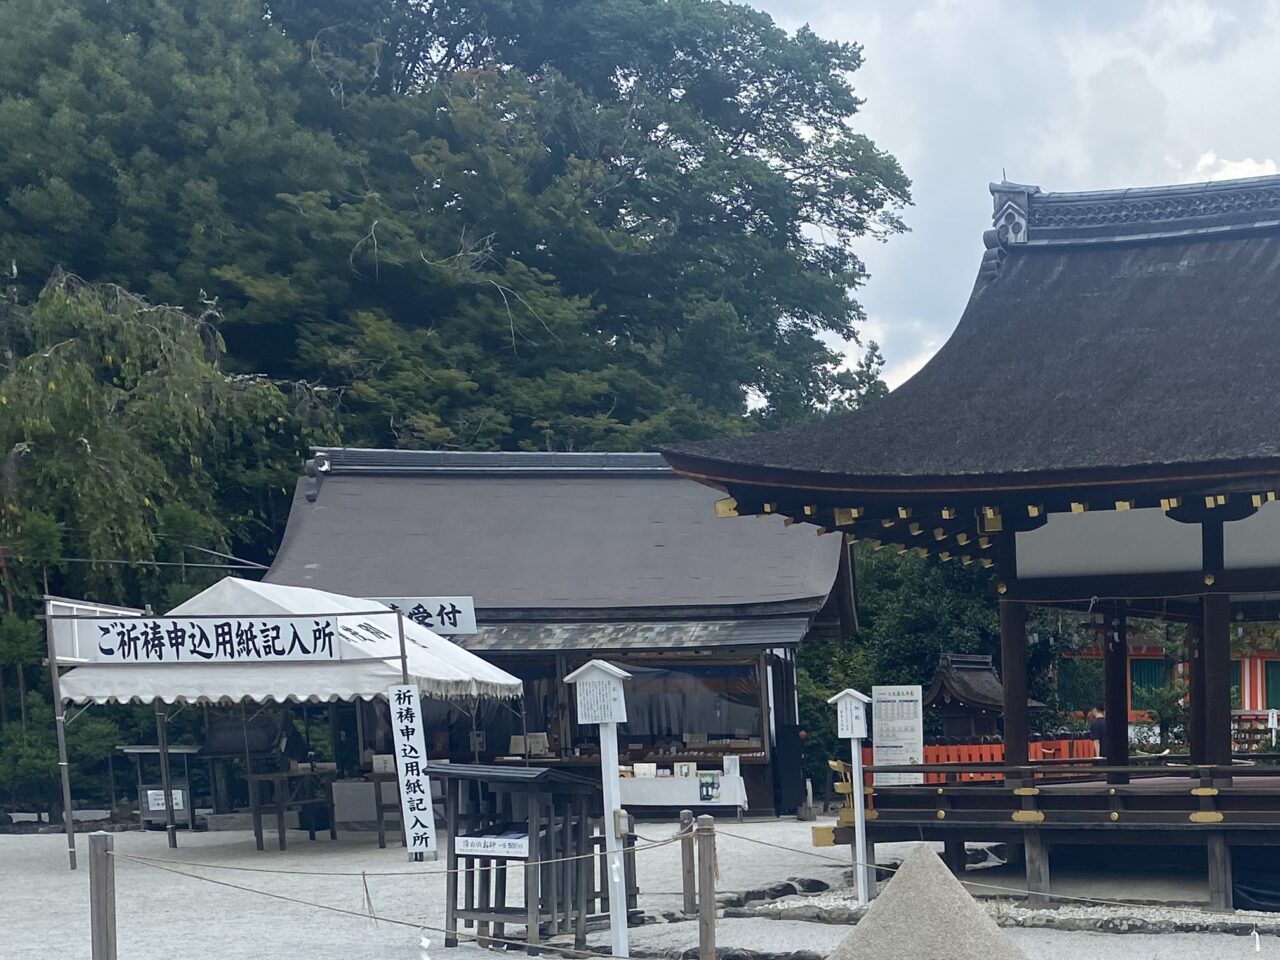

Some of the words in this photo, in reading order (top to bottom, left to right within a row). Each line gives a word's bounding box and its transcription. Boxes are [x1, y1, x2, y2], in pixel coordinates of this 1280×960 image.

[388, 602, 463, 628] 受付
[97, 619, 335, 661] ご祈祷申込用紙記入所
[394, 689, 431, 849] 祈祷申込用紙記入所
